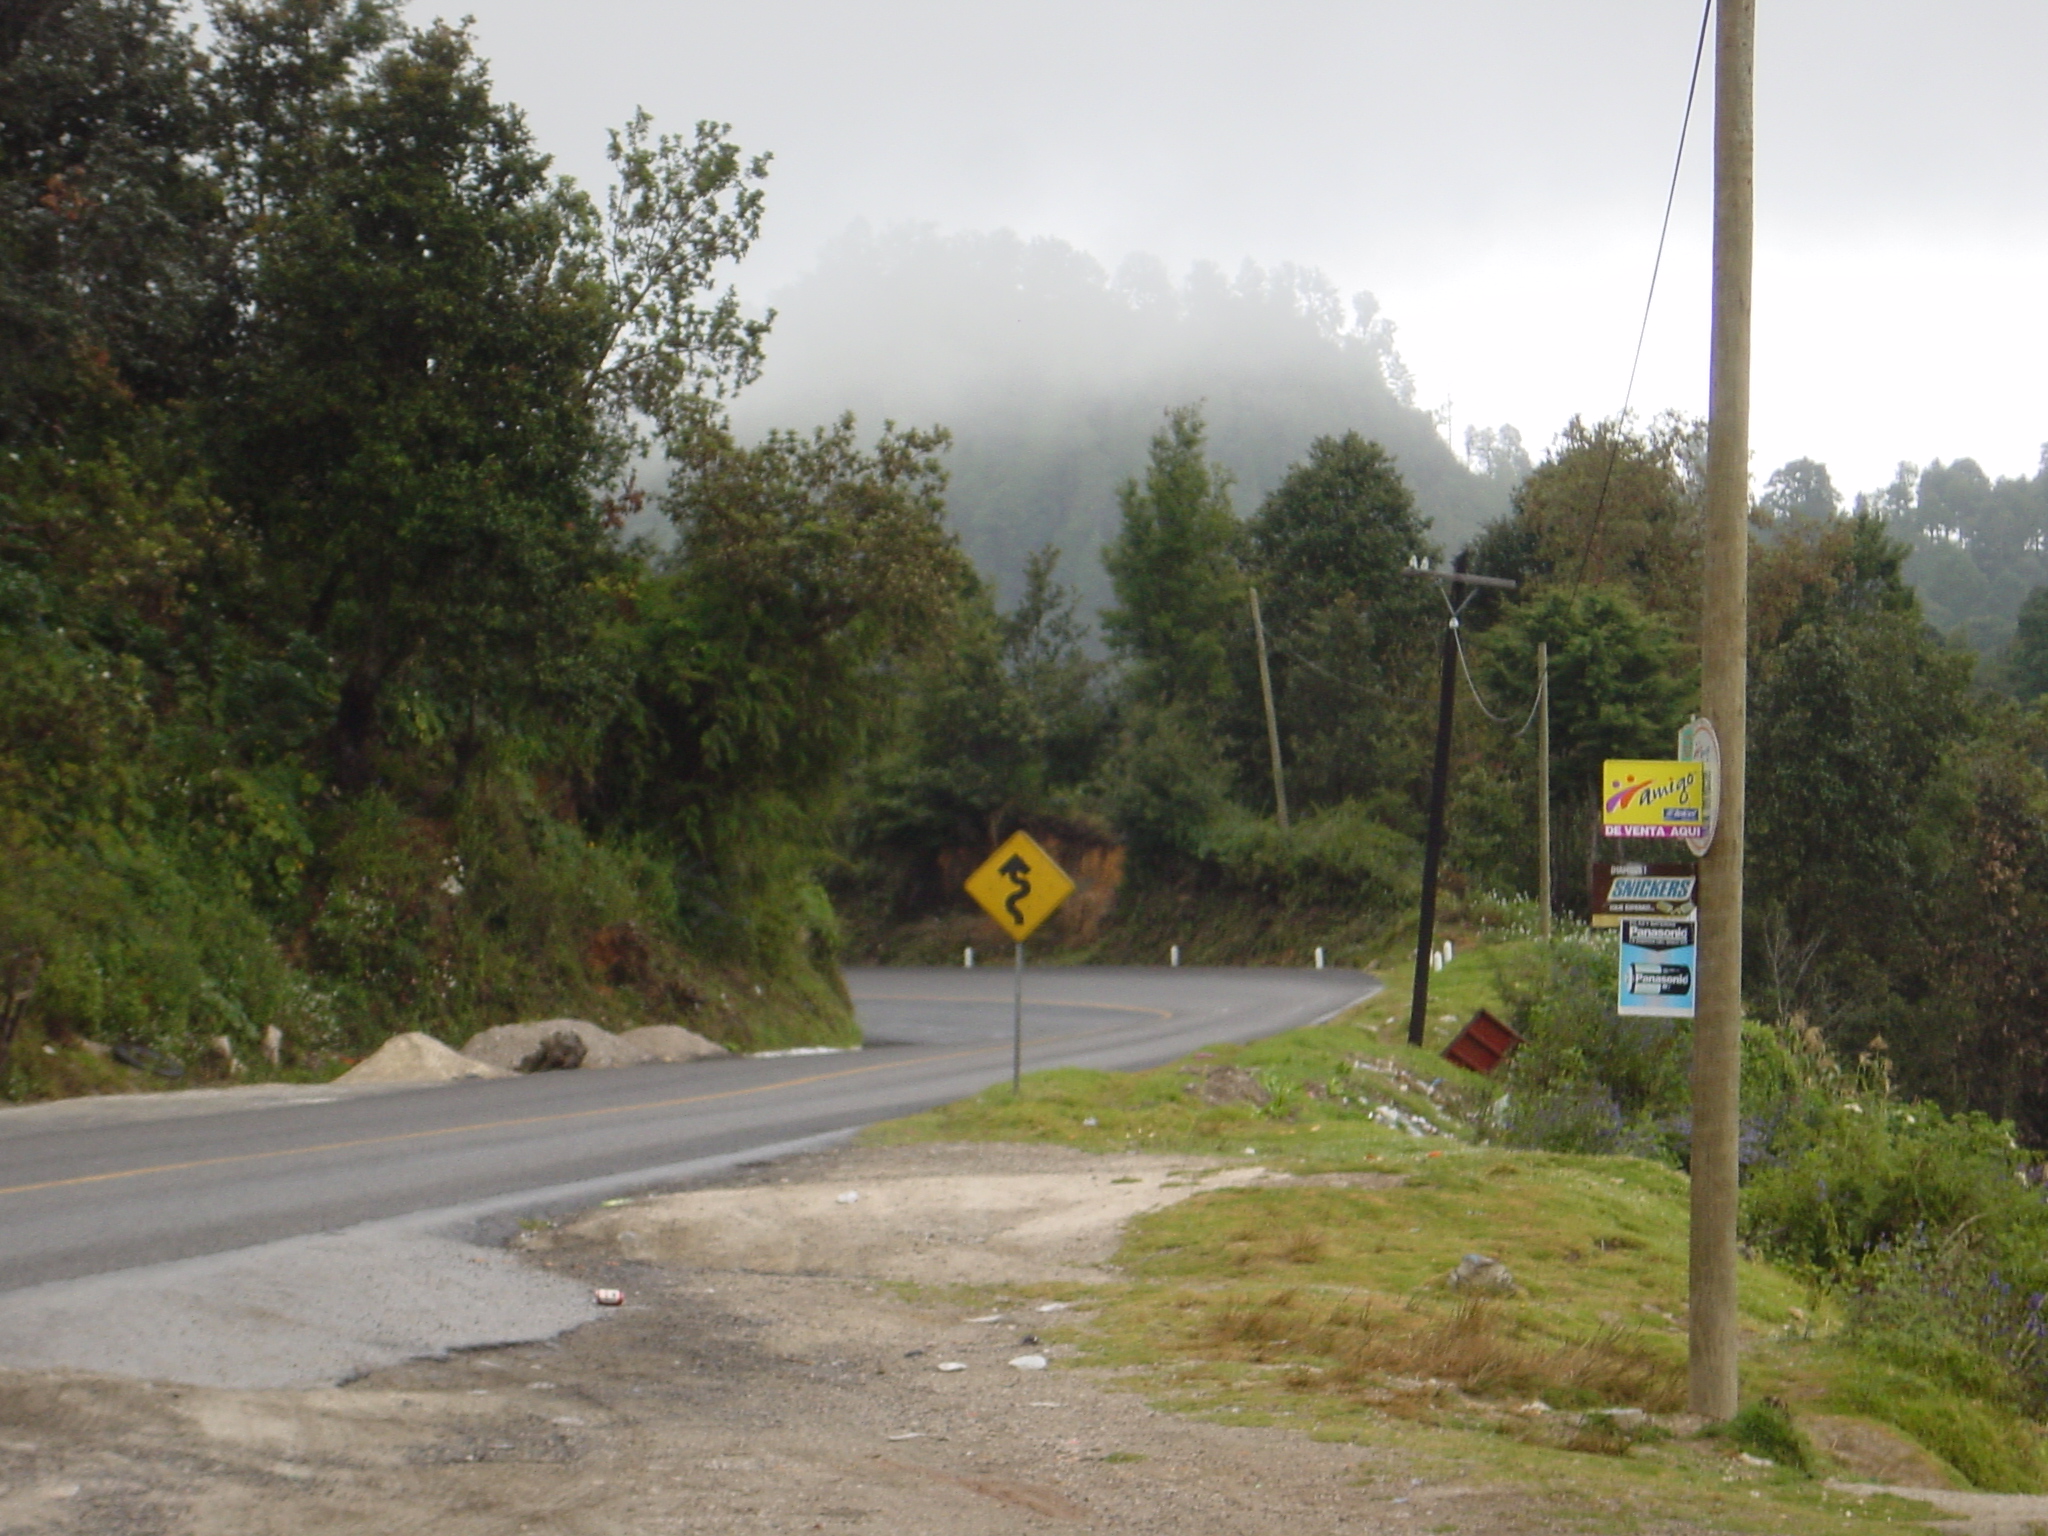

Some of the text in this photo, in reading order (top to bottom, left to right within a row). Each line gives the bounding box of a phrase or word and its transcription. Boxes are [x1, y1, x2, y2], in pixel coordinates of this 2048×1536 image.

[1639, 773, 1694, 805] amigo
[1605, 826, 1701, 837] DE VENTA AQUI
[1612, 879, 1691, 898] SNICKERS
[1630, 926, 1688, 939] Panasonic
[1636, 974, 1689, 984] Panasonic
